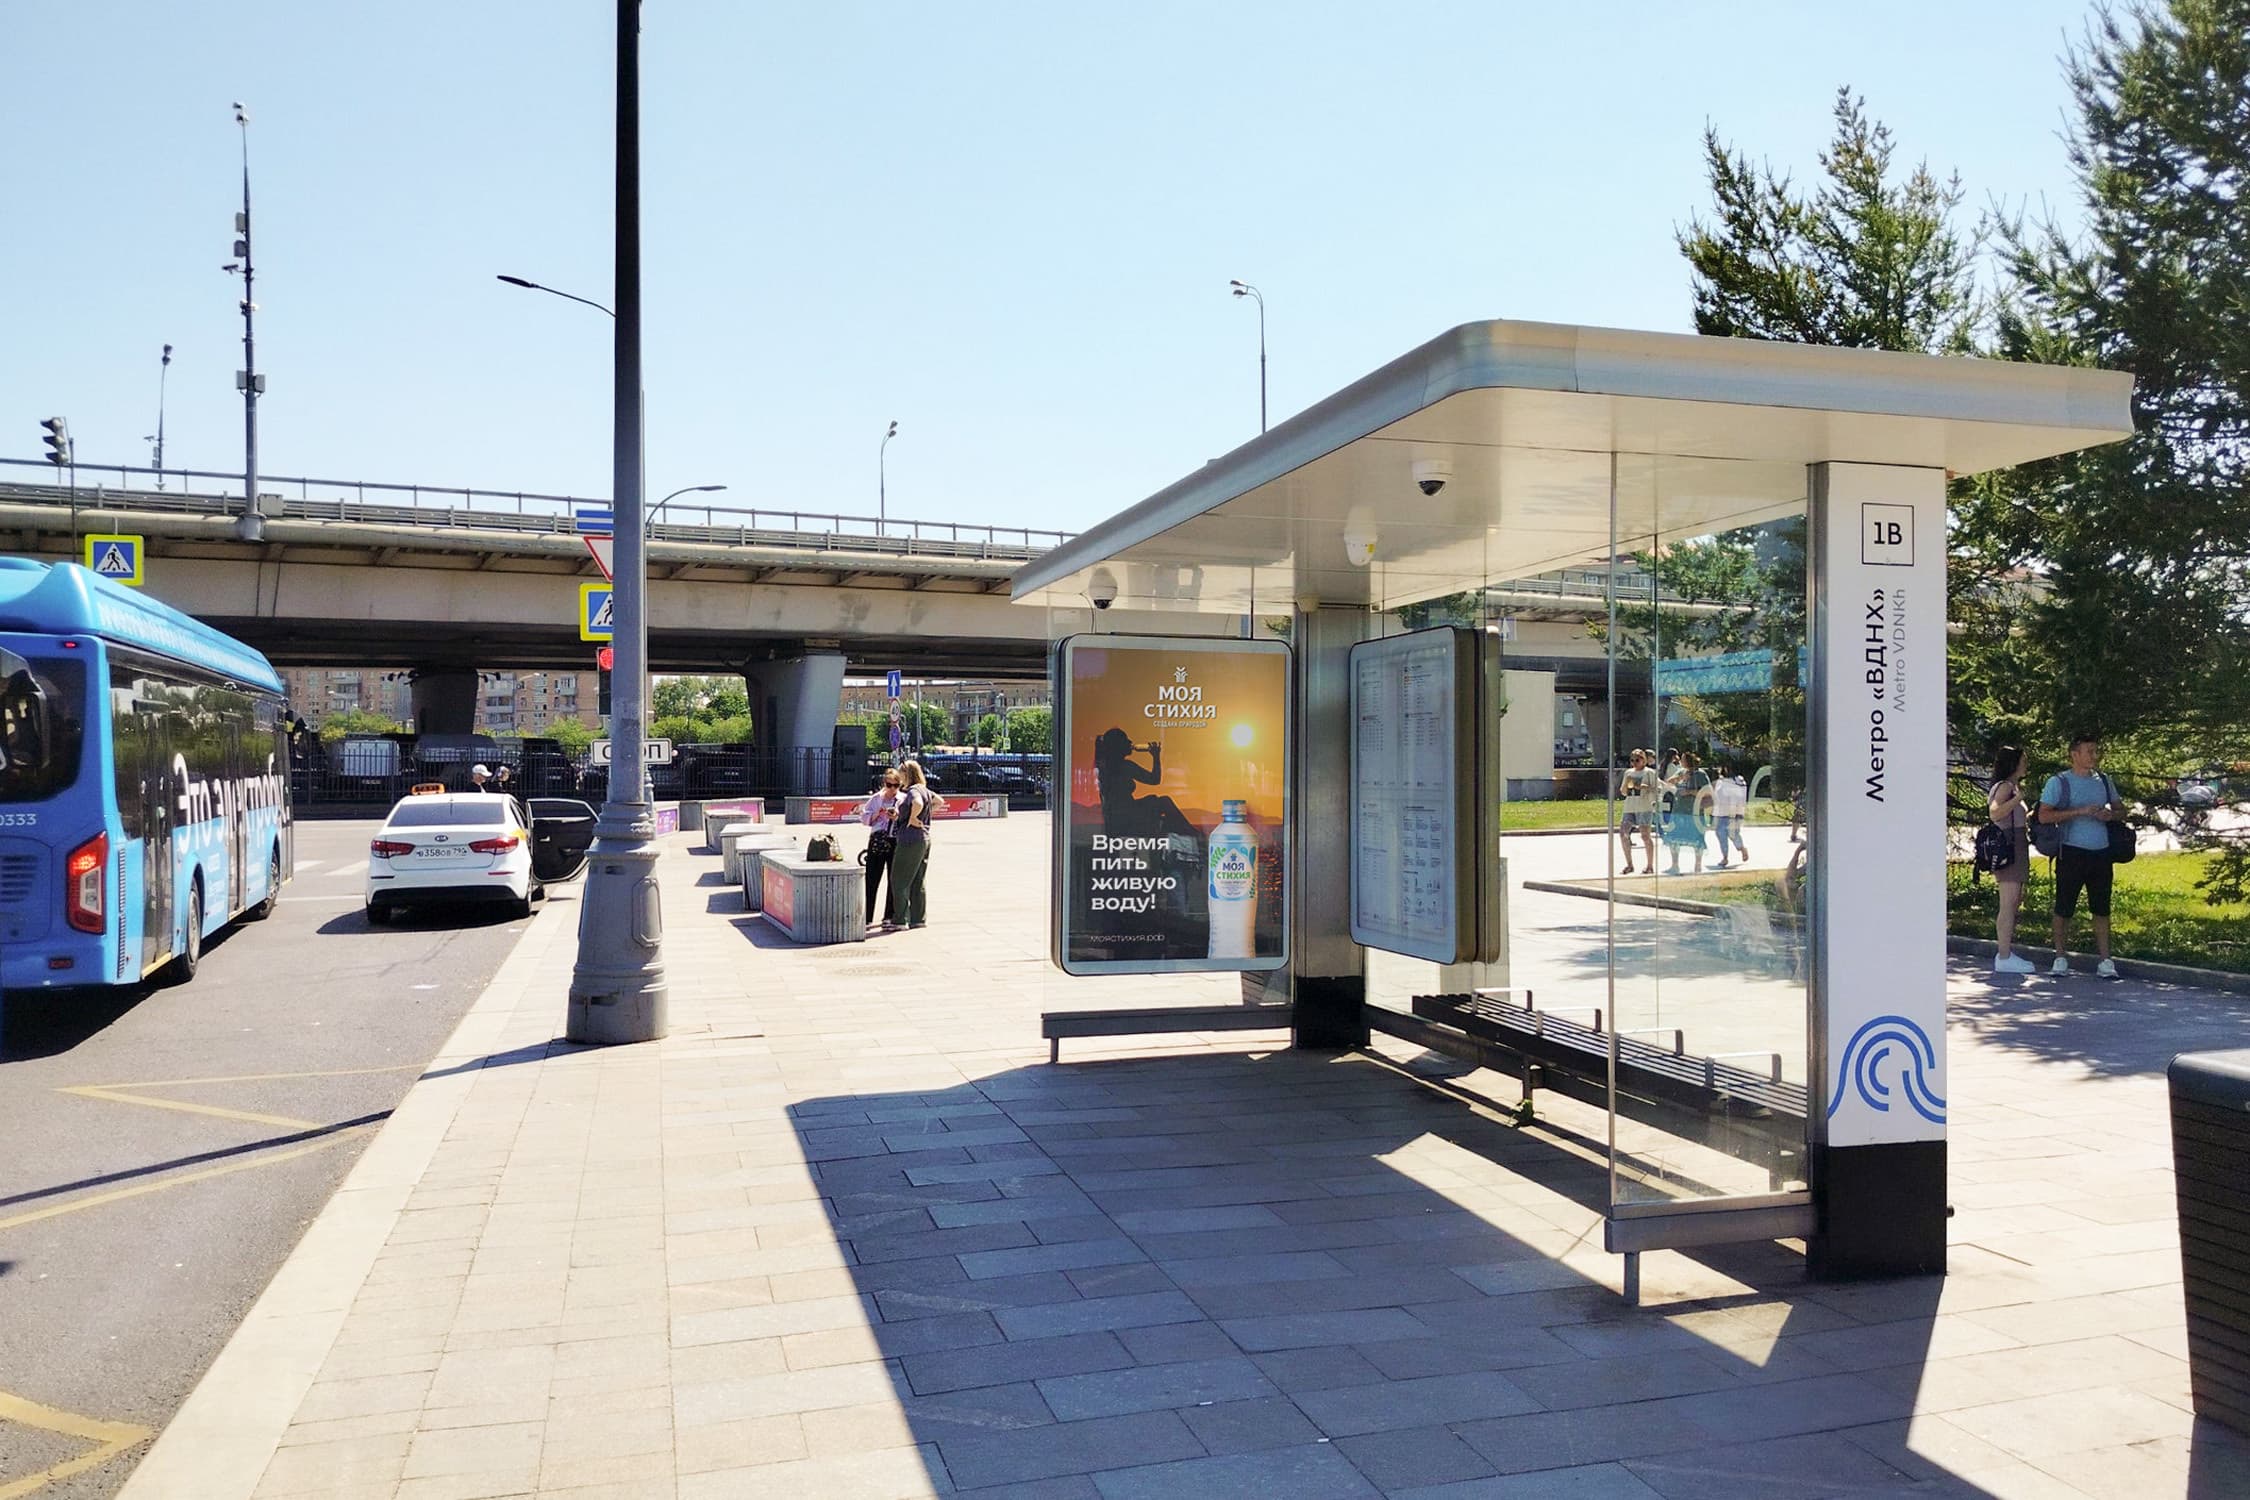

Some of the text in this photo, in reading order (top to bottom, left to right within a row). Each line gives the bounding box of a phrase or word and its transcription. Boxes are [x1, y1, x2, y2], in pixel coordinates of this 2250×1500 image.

[1892, 588, 1906, 713] Metro VDNKh
[1158, 685, 1203, 702] МОЯ
[1866, 588, 1889, 803] Метро «ВДНХ»
[1143, 703, 1217, 719] СТИХИЯ
[602, 744, 662, 760] СП
[173, 752, 213, 854] Это
[1092, 834, 1170, 854] Время
[1091, 857, 1148, 871] пить
[1222, 862, 1245, 871] МОЯ
[1216, 871, 1251, 879] СТИХИЯ
[1090, 876, 1177, 894] живую
[1091, 893, 1156, 914] воду!
